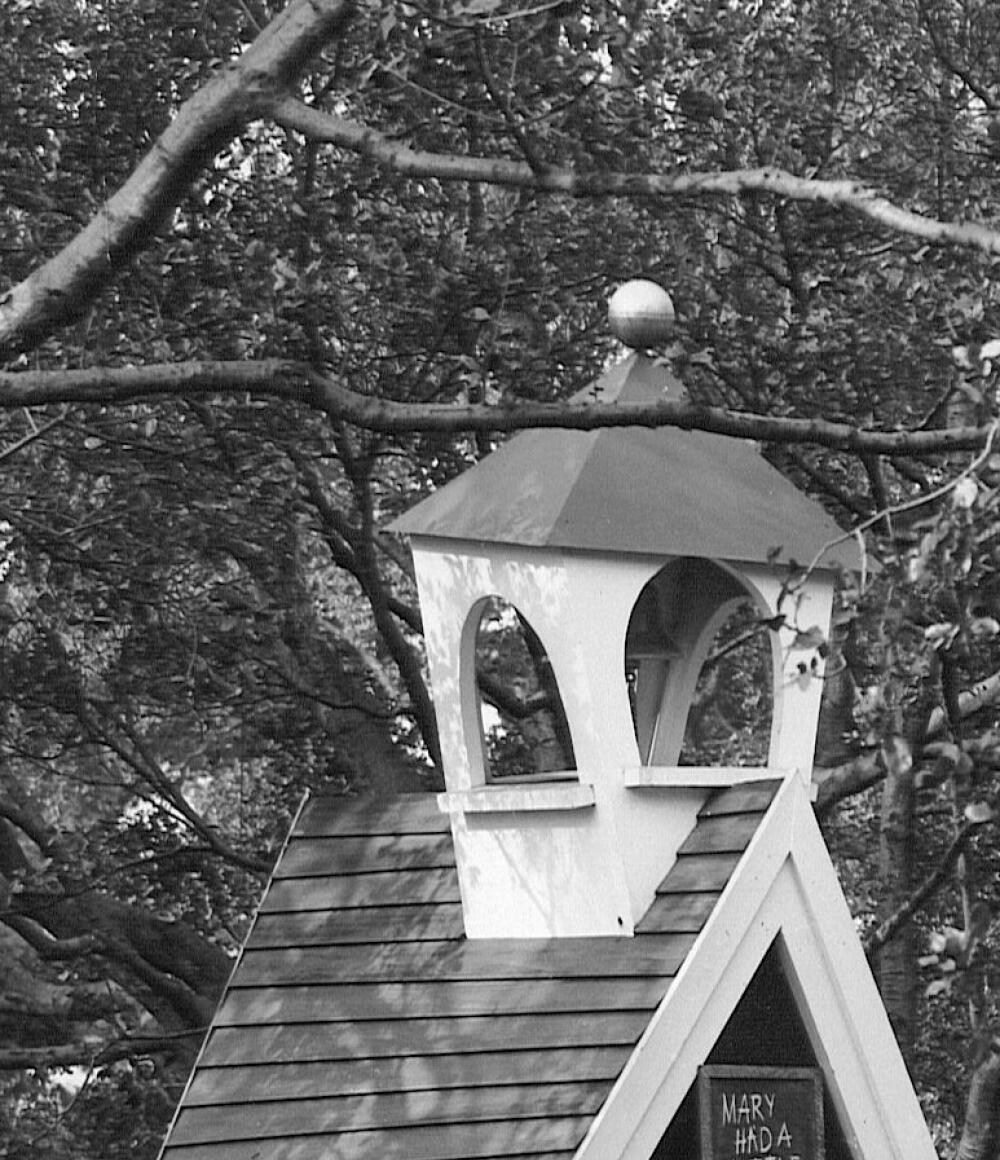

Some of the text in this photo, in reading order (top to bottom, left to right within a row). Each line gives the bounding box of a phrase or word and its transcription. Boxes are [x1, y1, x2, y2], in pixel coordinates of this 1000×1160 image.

[721, 1092, 776, 1126] MARY
[735, 1121, 793, 1155] HAD A
